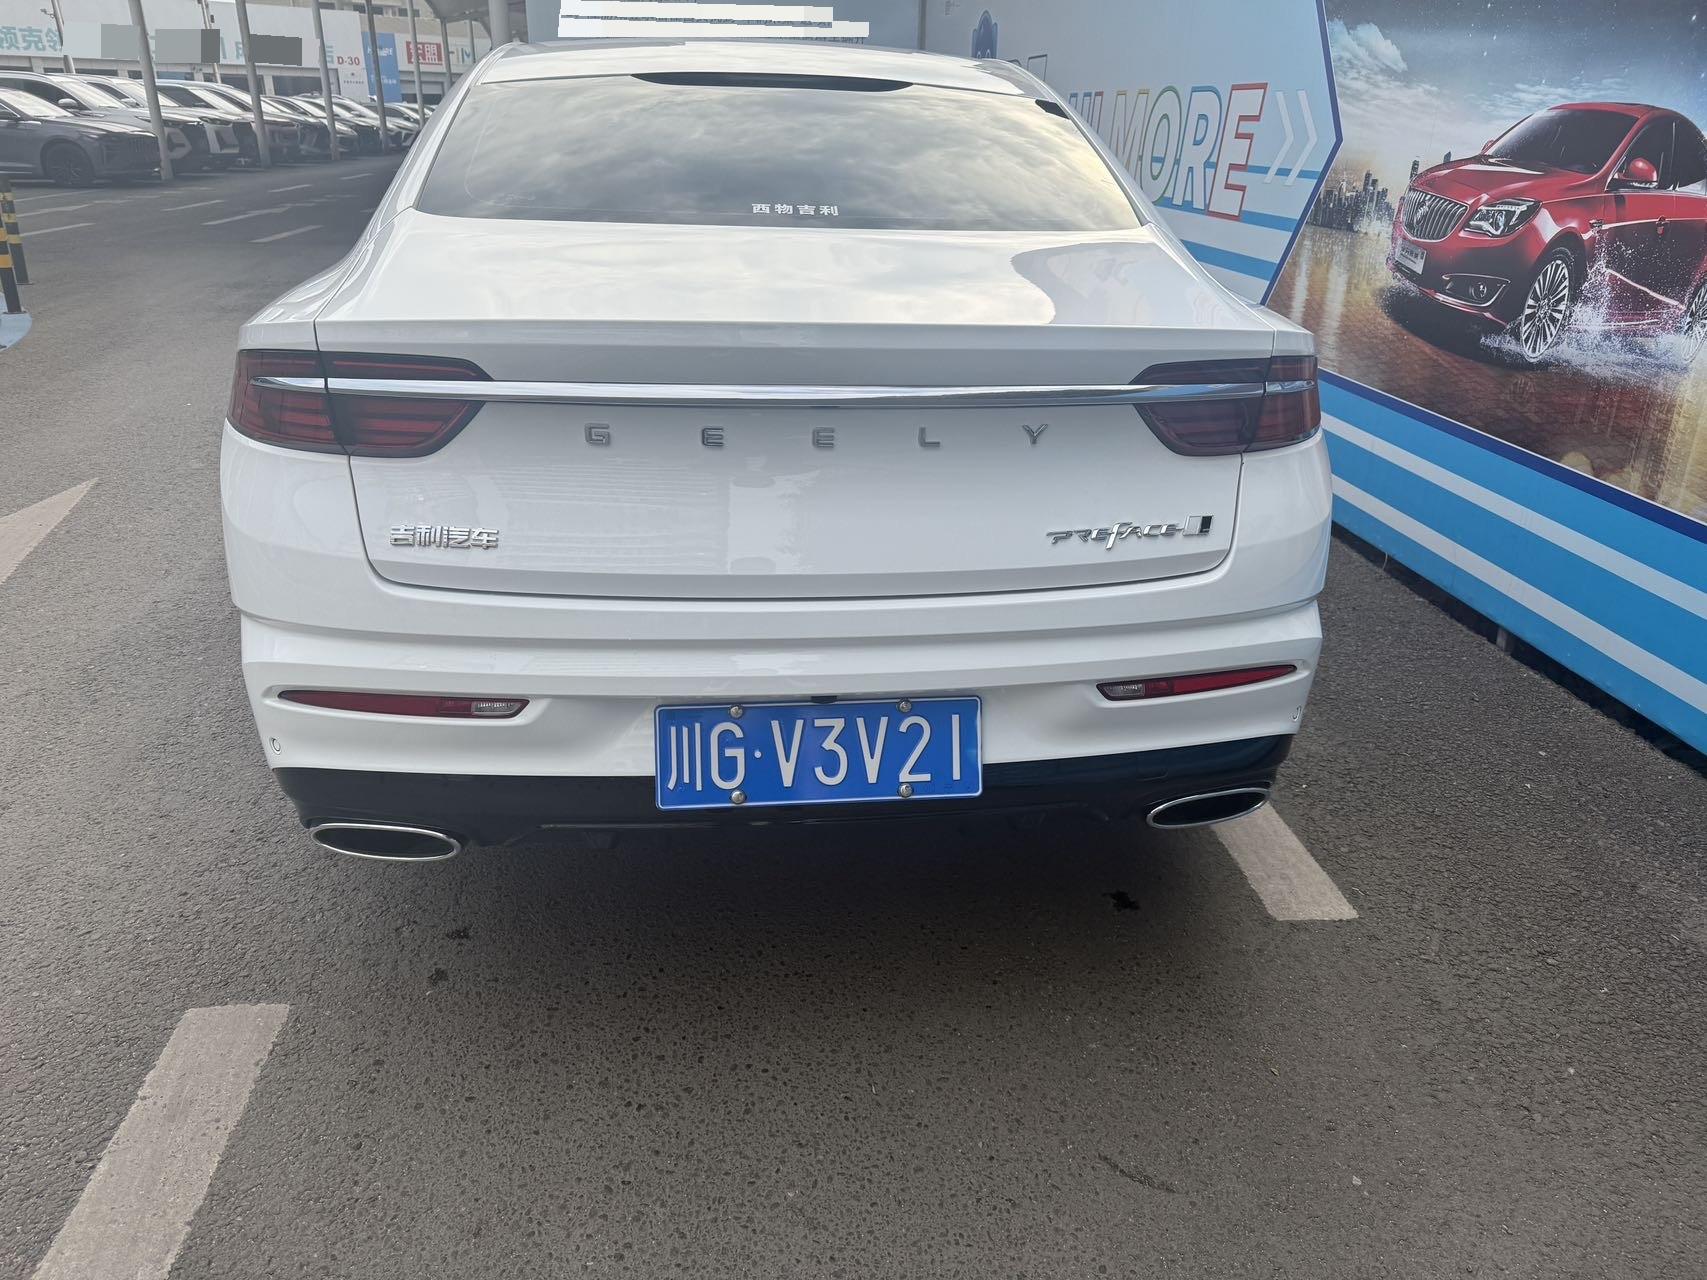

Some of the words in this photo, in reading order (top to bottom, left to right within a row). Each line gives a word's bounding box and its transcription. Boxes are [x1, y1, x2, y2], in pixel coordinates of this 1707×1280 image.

[1109, 82, 1269, 222] MORE
[751, 203, 840, 216] 西物吉利
[584, 422, 1048, 448] GEELY
[389, 524, 500, 550] 吉利汽车
